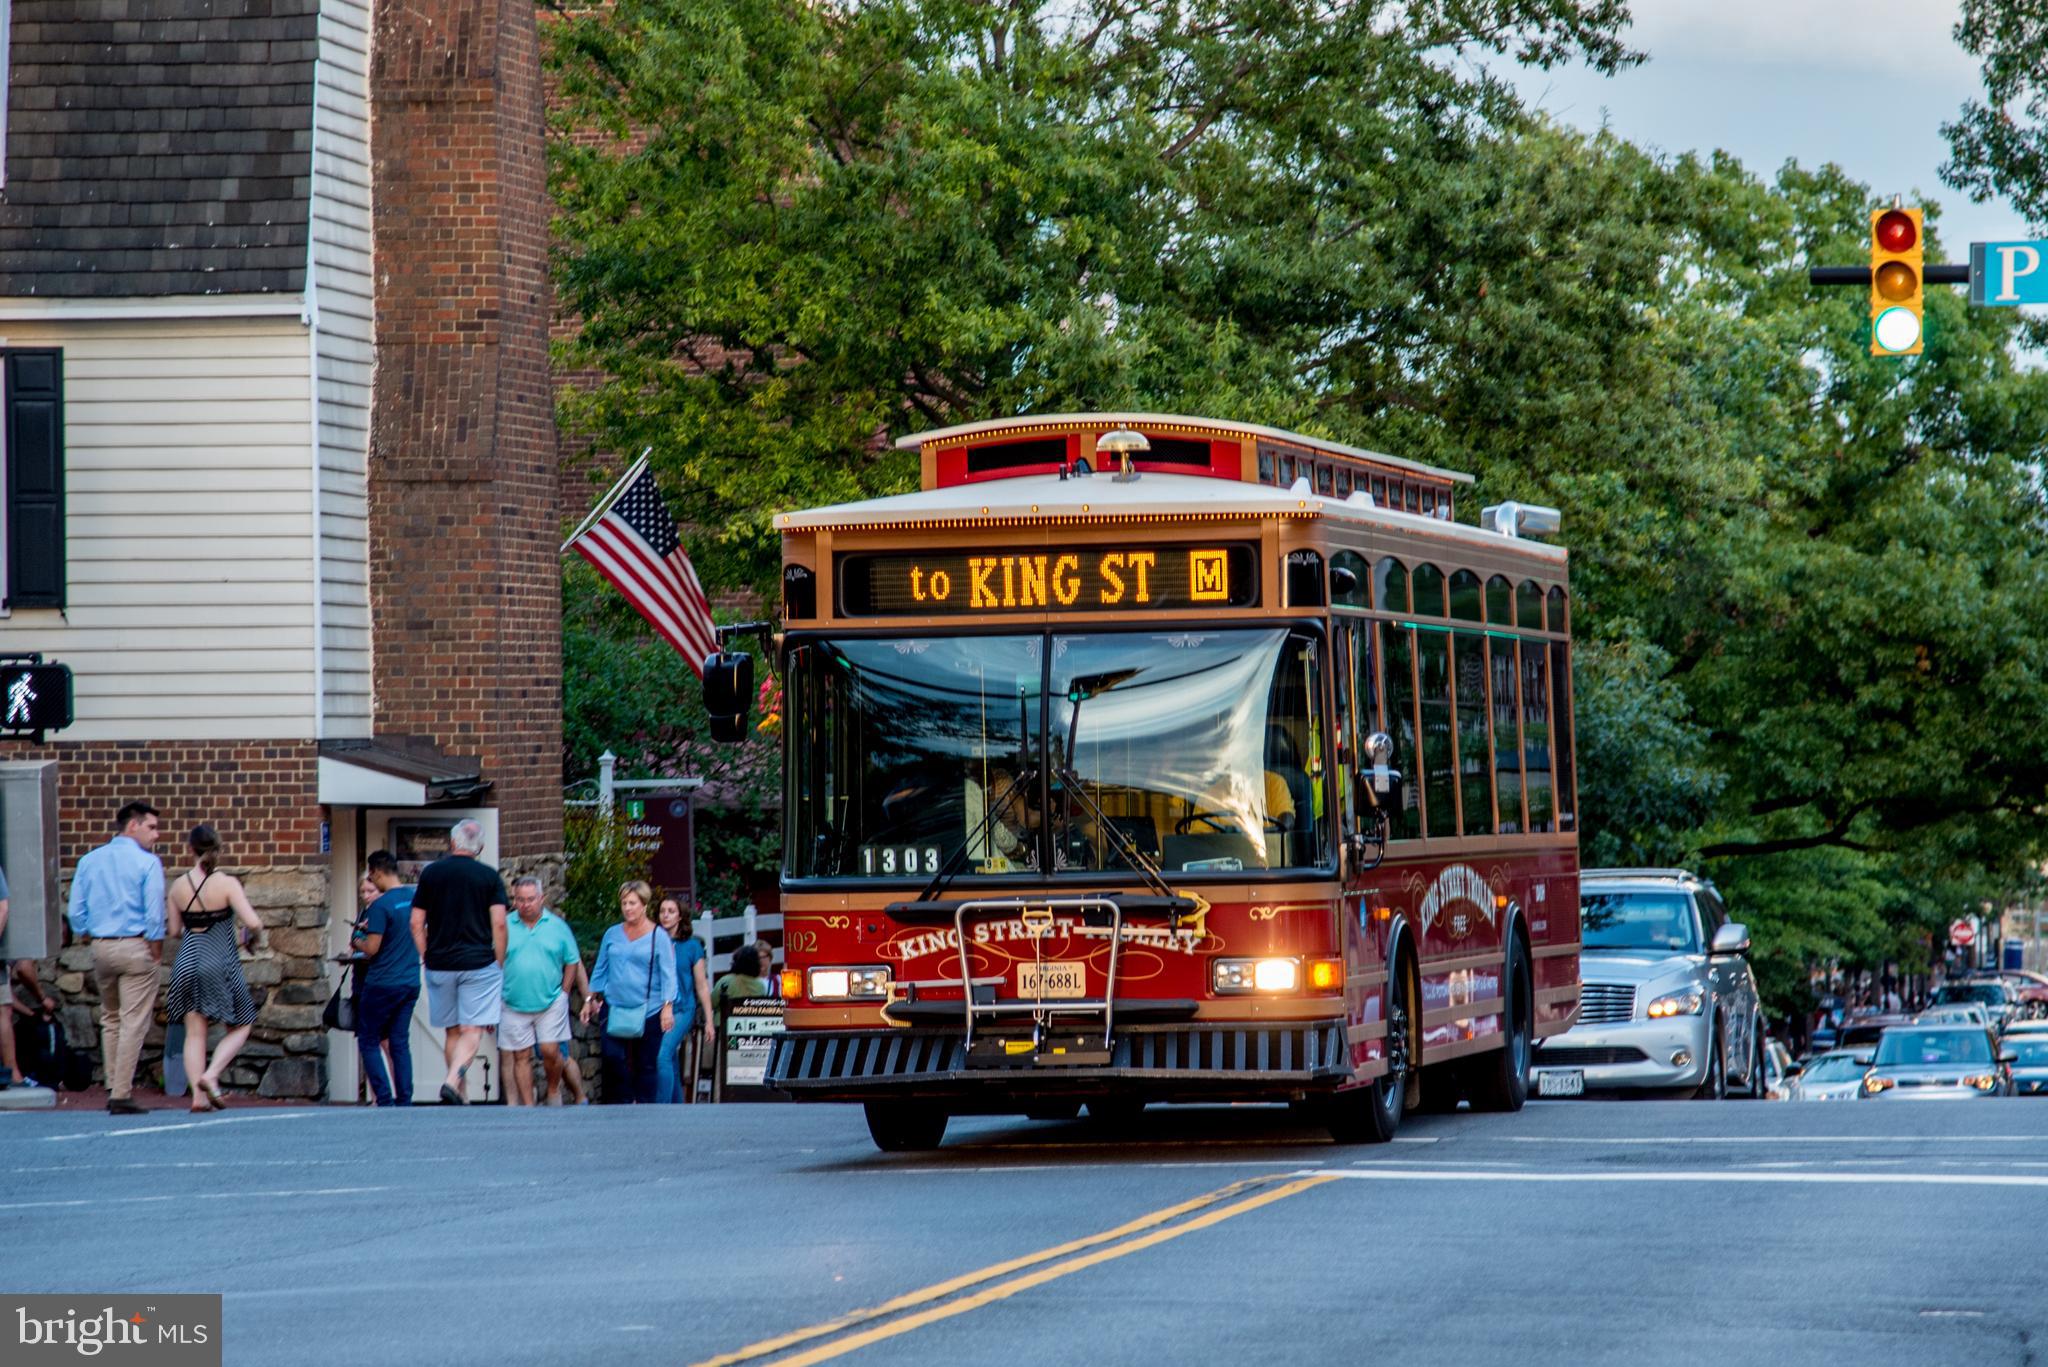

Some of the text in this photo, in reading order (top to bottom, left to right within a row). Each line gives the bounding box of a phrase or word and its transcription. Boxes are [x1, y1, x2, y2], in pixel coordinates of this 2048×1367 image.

[911, 566, 950, 600] to
[969, 556, 1081, 607] KING
[1100, 553, 1155, 604] ST
[863, 847, 938, 873] 1303
[1421, 865, 1496, 936] KING STREET TROLLEY
[974, 918, 1074, 943] STREET
